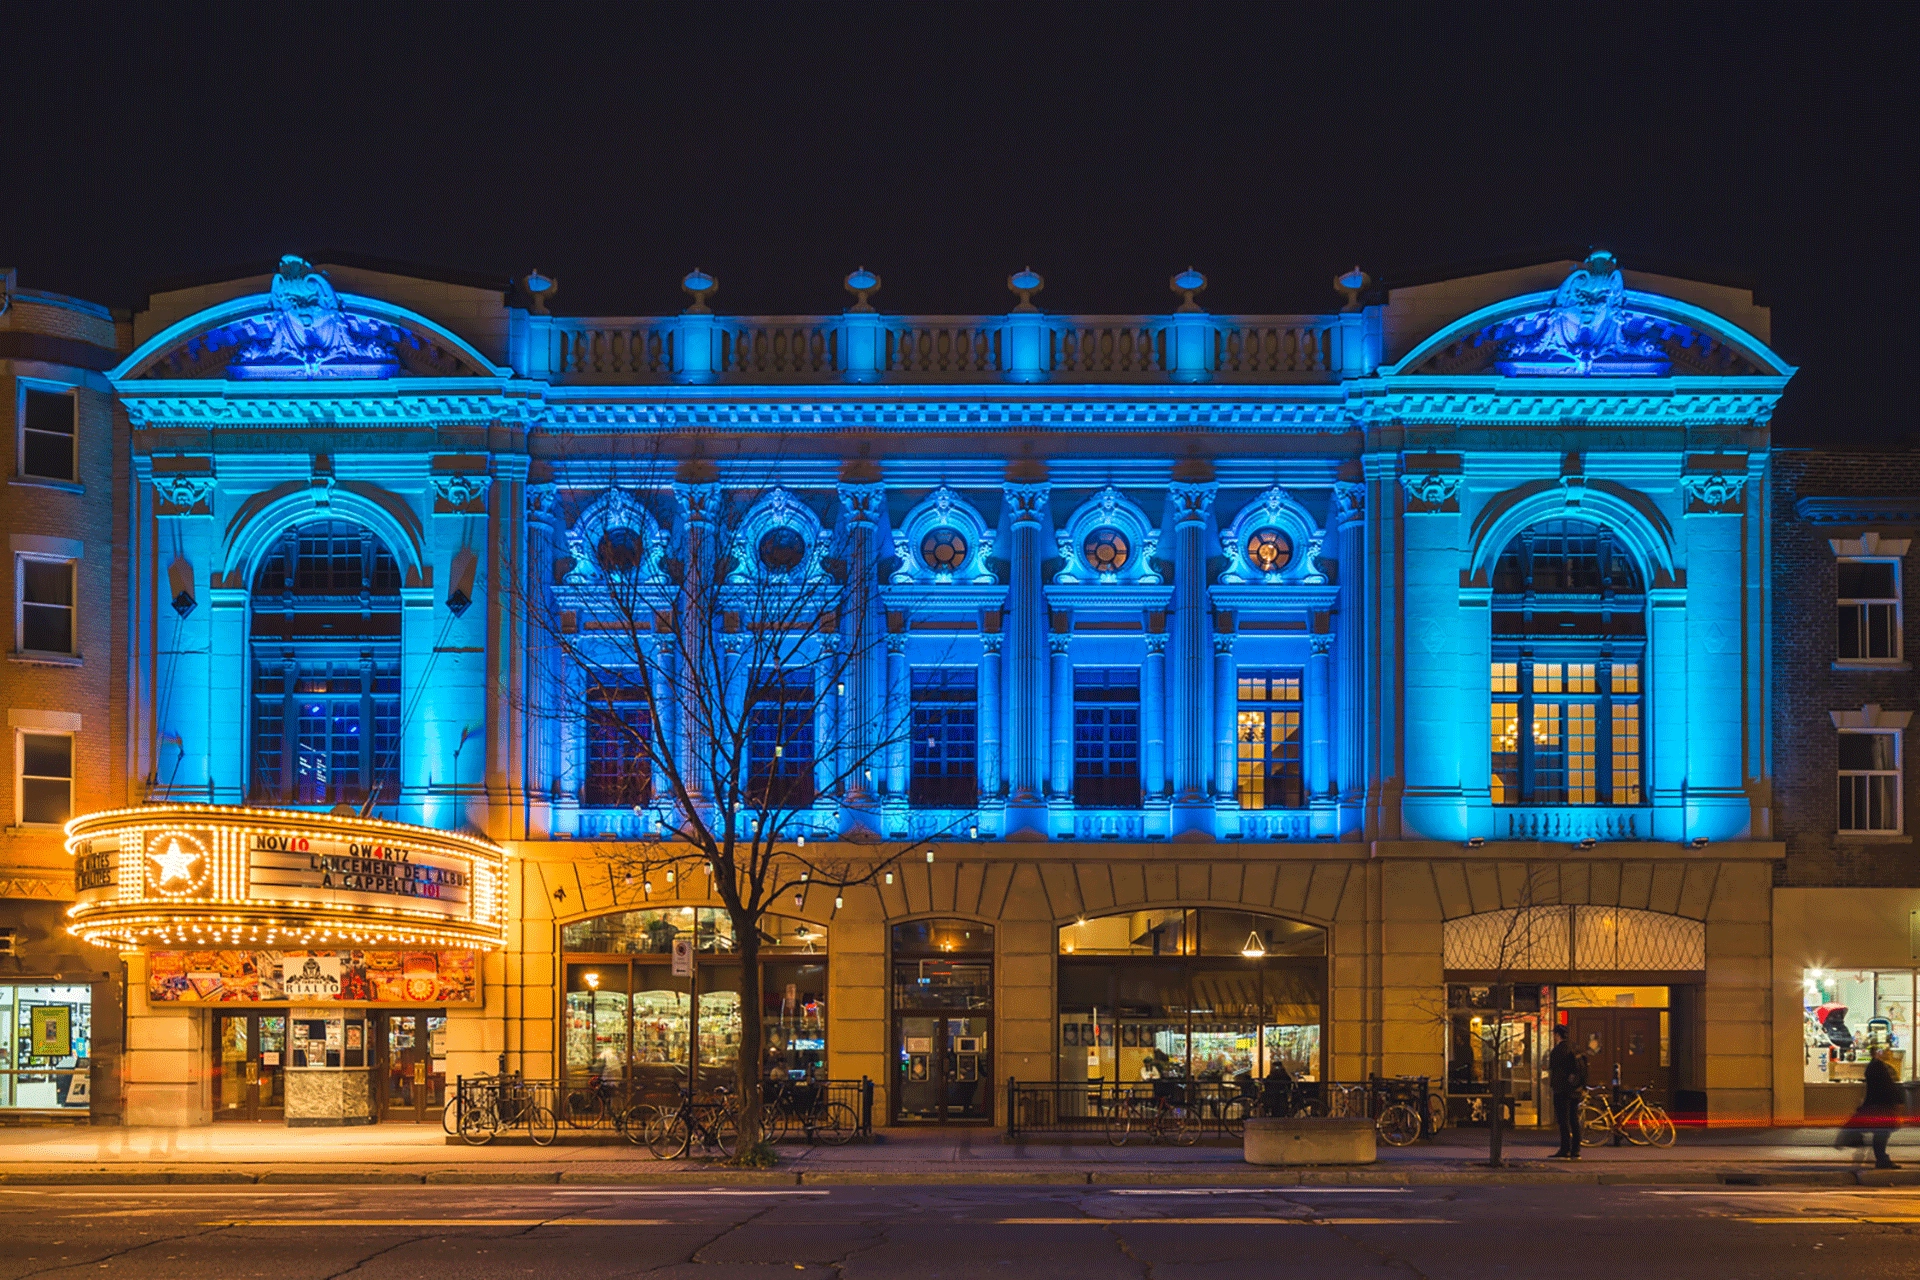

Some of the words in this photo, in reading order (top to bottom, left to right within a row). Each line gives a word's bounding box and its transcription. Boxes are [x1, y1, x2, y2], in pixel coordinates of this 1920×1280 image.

[349, 844, 409, 862] QW4RTZ
[310, 856, 396, 876] LANCEMENT
[404, 865, 420, 880] DE
[322, 874, 333, 888] A
[343, 875, 418, 896] CAPPELLA
[423, 884, 439, 898] 101
[286, 984, 339, 993] RIALTO
